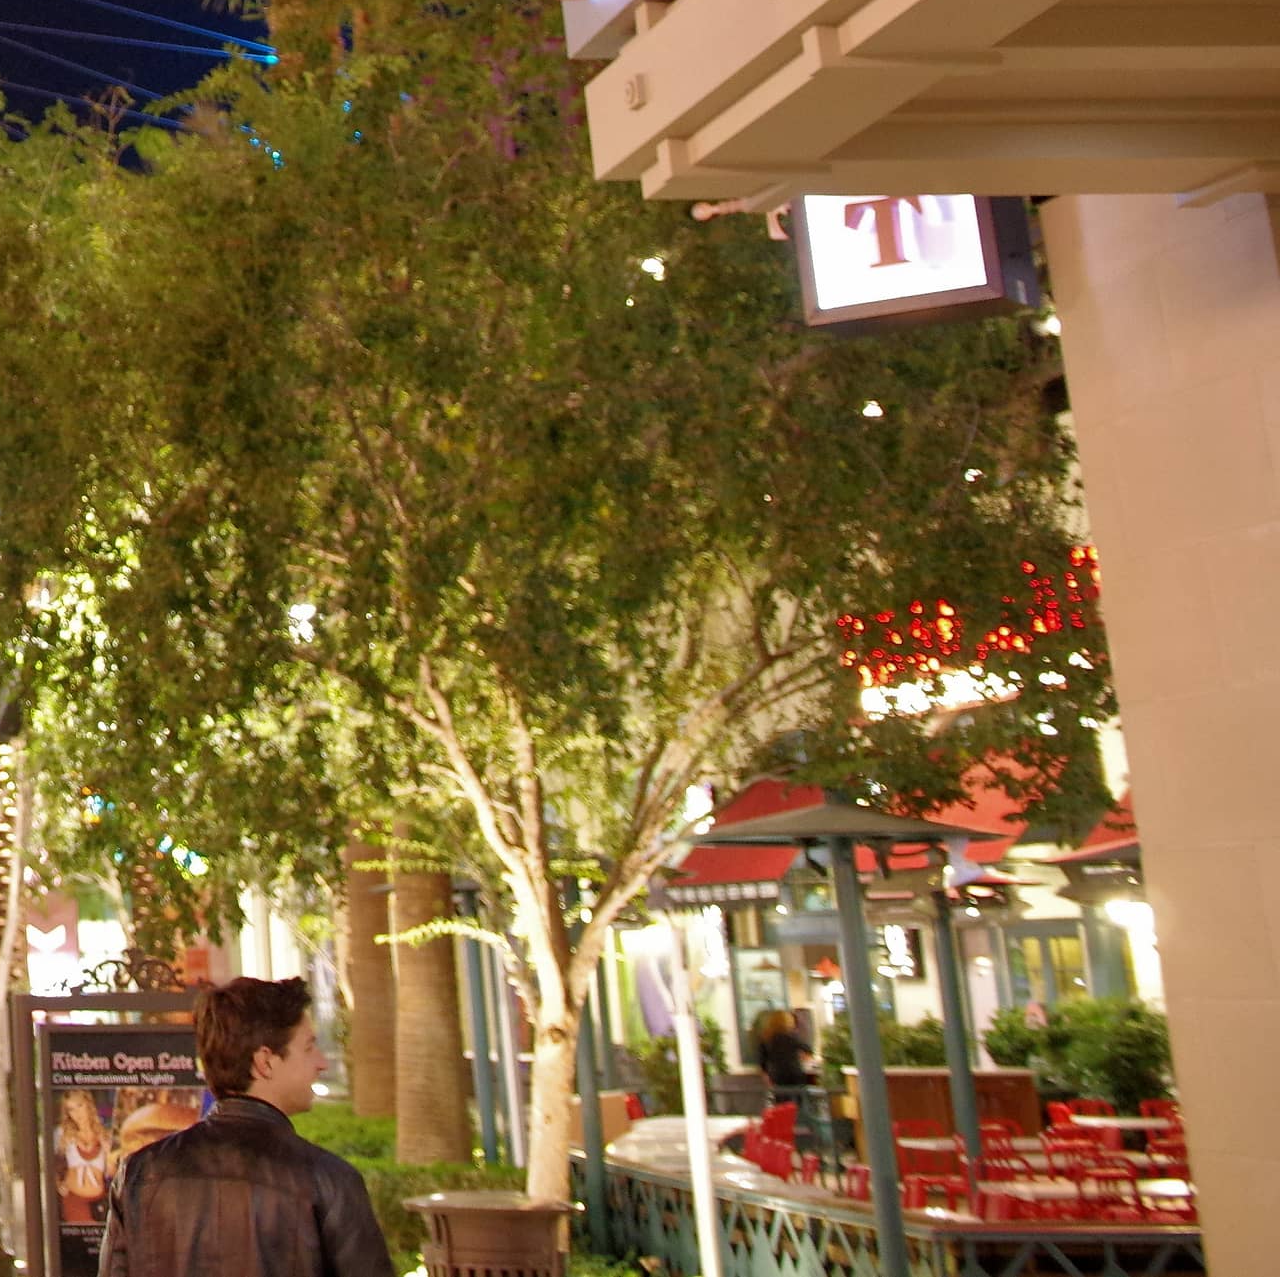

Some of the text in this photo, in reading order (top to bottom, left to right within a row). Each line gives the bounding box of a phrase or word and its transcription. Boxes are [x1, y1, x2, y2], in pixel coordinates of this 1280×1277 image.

[51, 1051, 194, 1074] Kitchen Open Late
